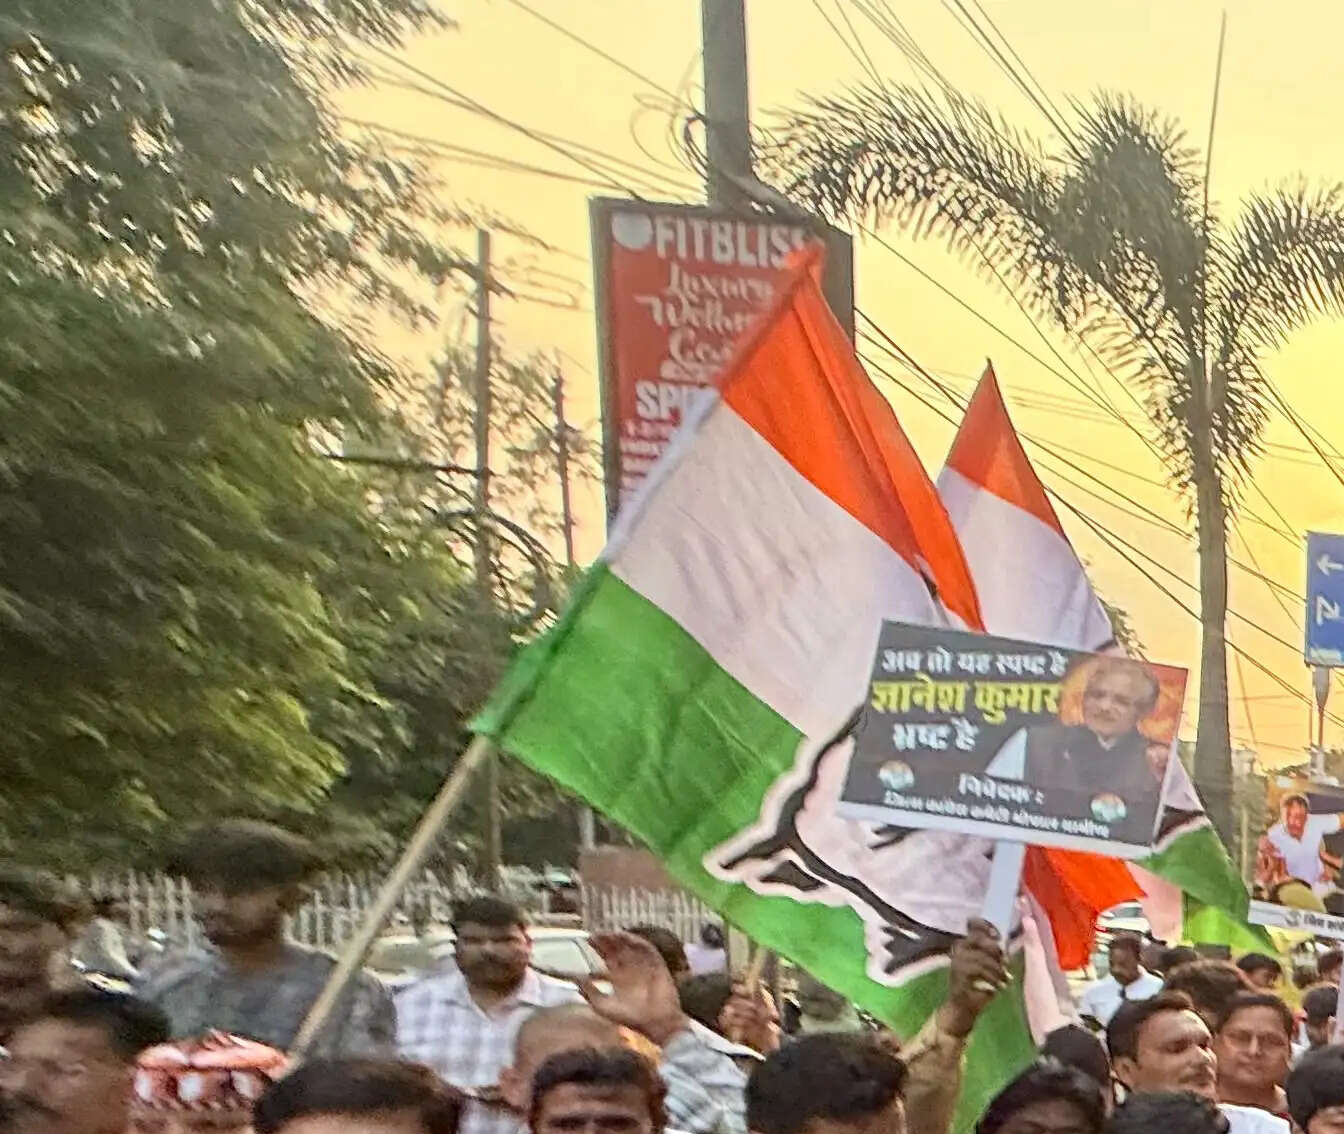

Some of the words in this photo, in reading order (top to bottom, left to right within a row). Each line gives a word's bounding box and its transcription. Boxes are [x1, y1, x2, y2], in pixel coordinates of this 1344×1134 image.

[927, 645, 950, 674] तो
[957, 651, 990, 675] यह
[1050, 650, 1069, 676] है
[871, 675, 967, 714] ज्ञानेश
[974, 681, 1062, 724] कुमार
[951, 714, 979, 751] है
